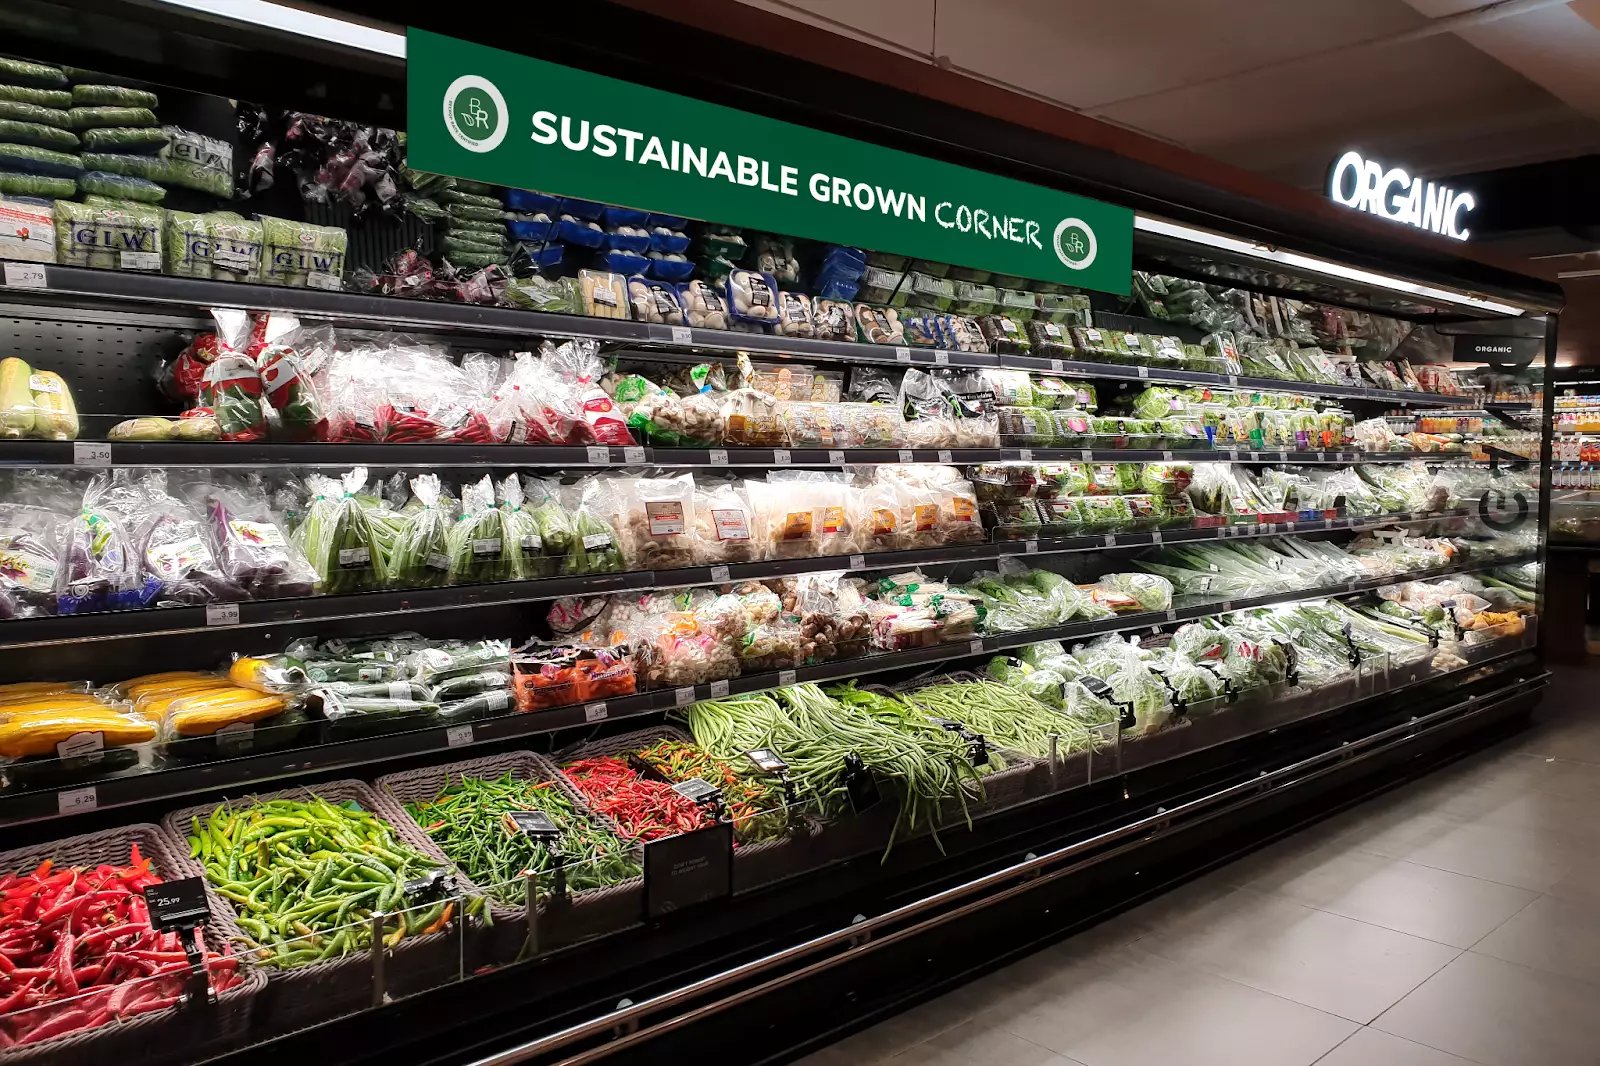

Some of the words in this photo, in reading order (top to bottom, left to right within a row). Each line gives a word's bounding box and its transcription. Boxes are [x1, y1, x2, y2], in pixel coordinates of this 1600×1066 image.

[531, 110, 798, 195] SUSTAINABLE
[809, 172, 926, 222] GROWN
[935, 202, 1042, 249] CORNER
[1331, 151, 1475, 241] ORGANIC
[23, 272, 44, 280] 2.79
[91, 451, 110, 459] 3.50
[75, 795, 95, 804] 6.29
[157, 897, 180, 907] 25.99
